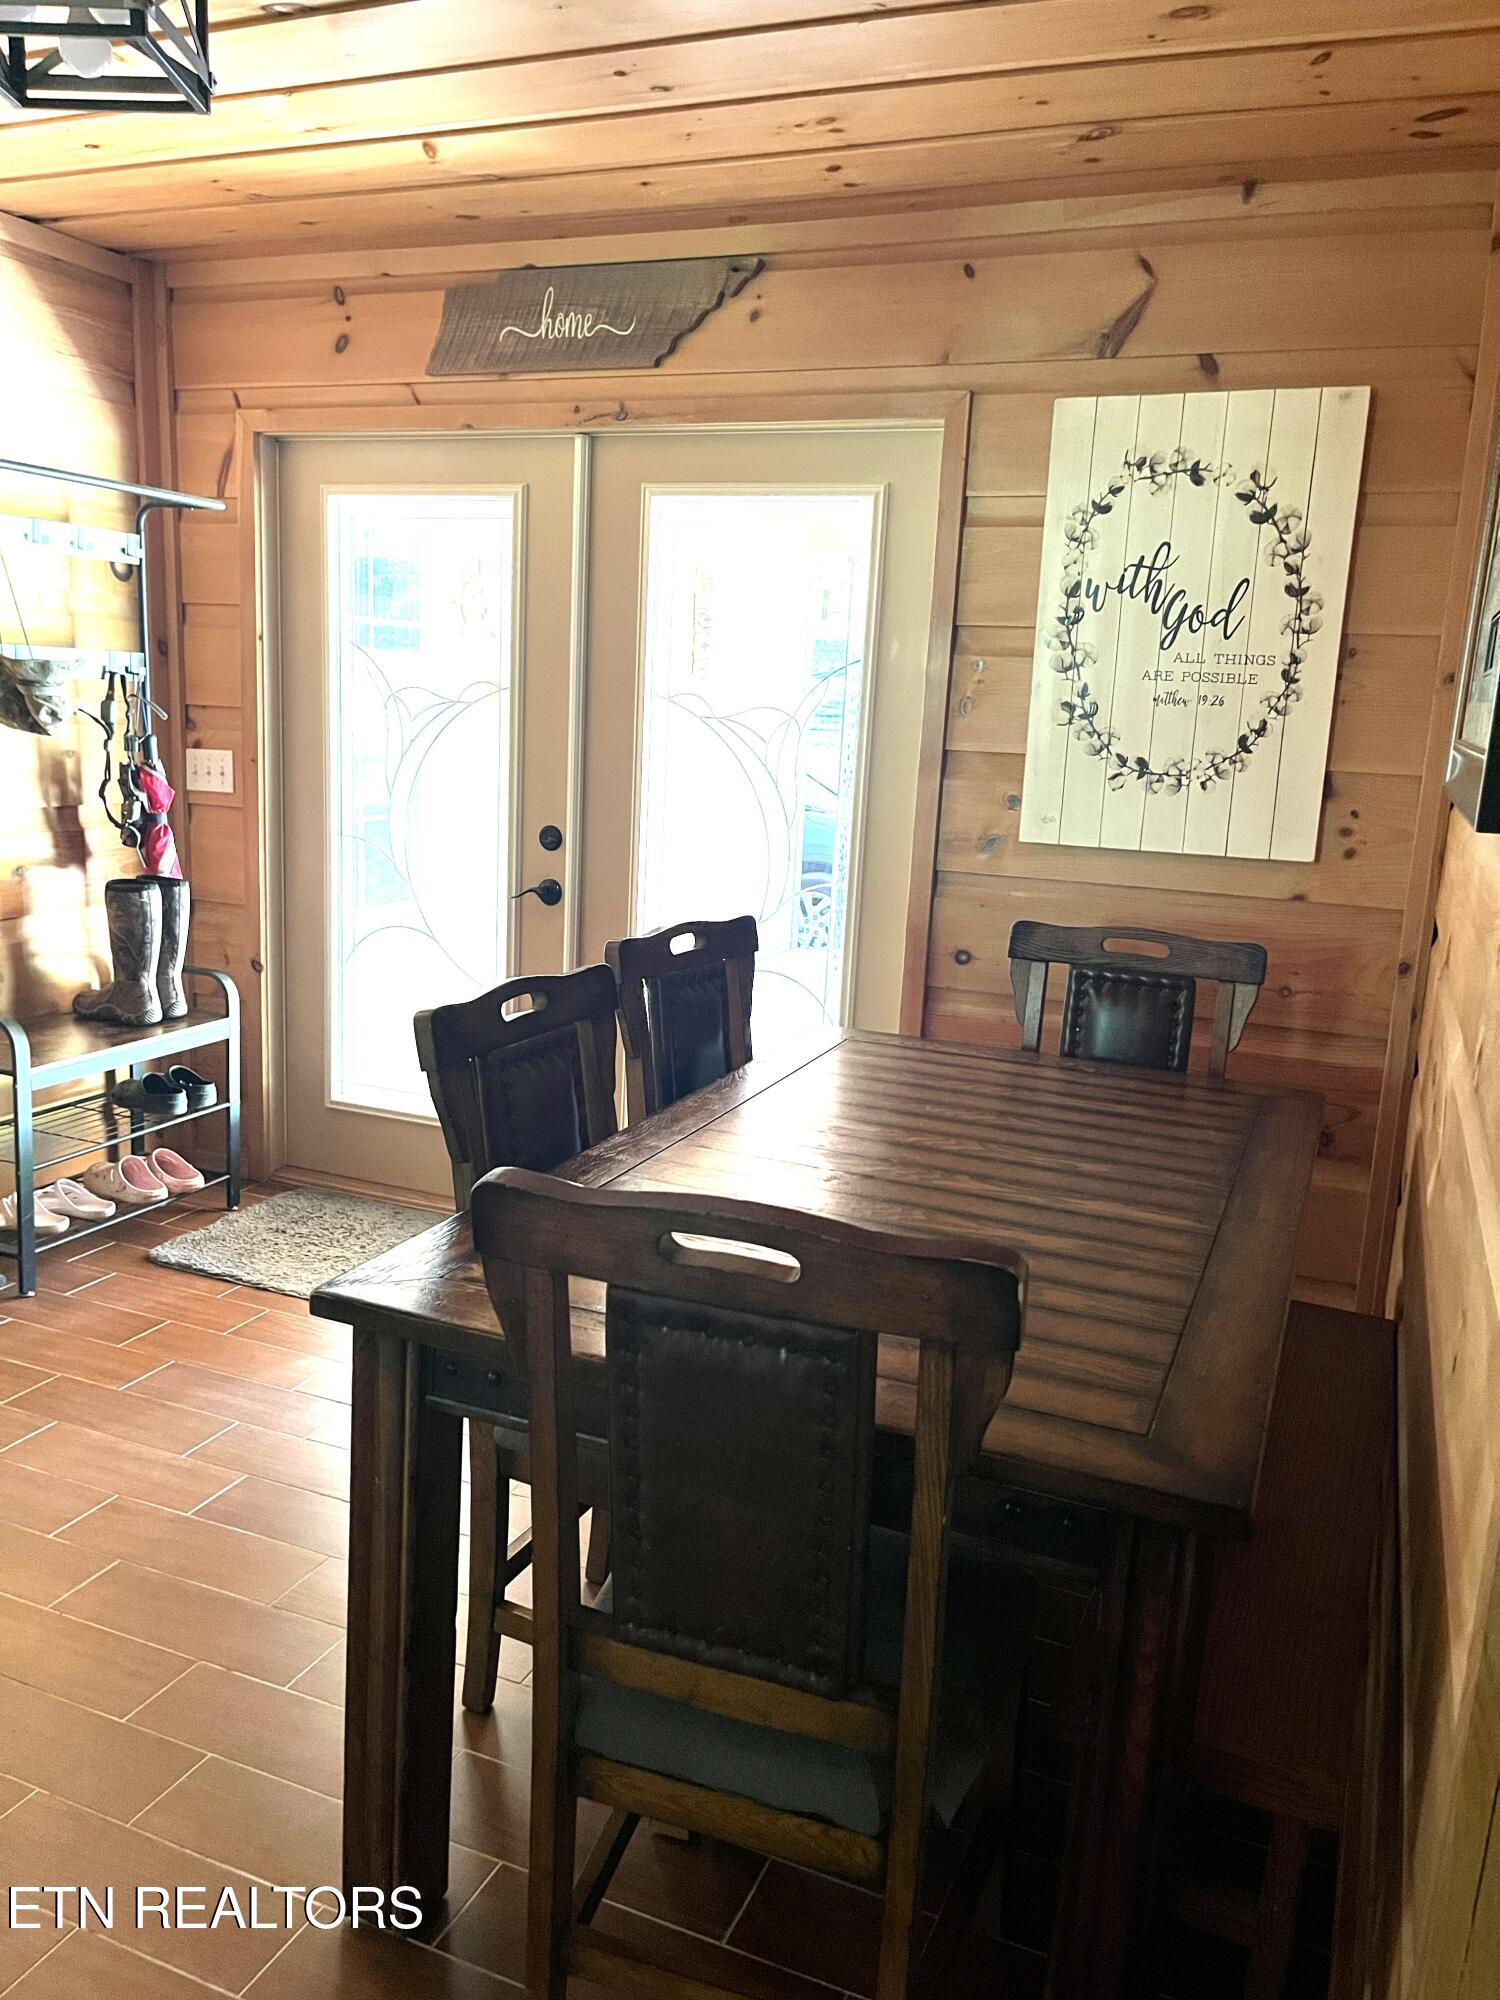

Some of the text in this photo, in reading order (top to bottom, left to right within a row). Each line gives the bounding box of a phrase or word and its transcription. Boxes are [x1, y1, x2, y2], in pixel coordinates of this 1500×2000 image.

[499, 286, 636, 343] home
[1085, 541, 1180, 615] with
[1173, 652, 1276, 666] ALL THINGS
[1142, 670, 1258, 685] ARE POSSIBLE
